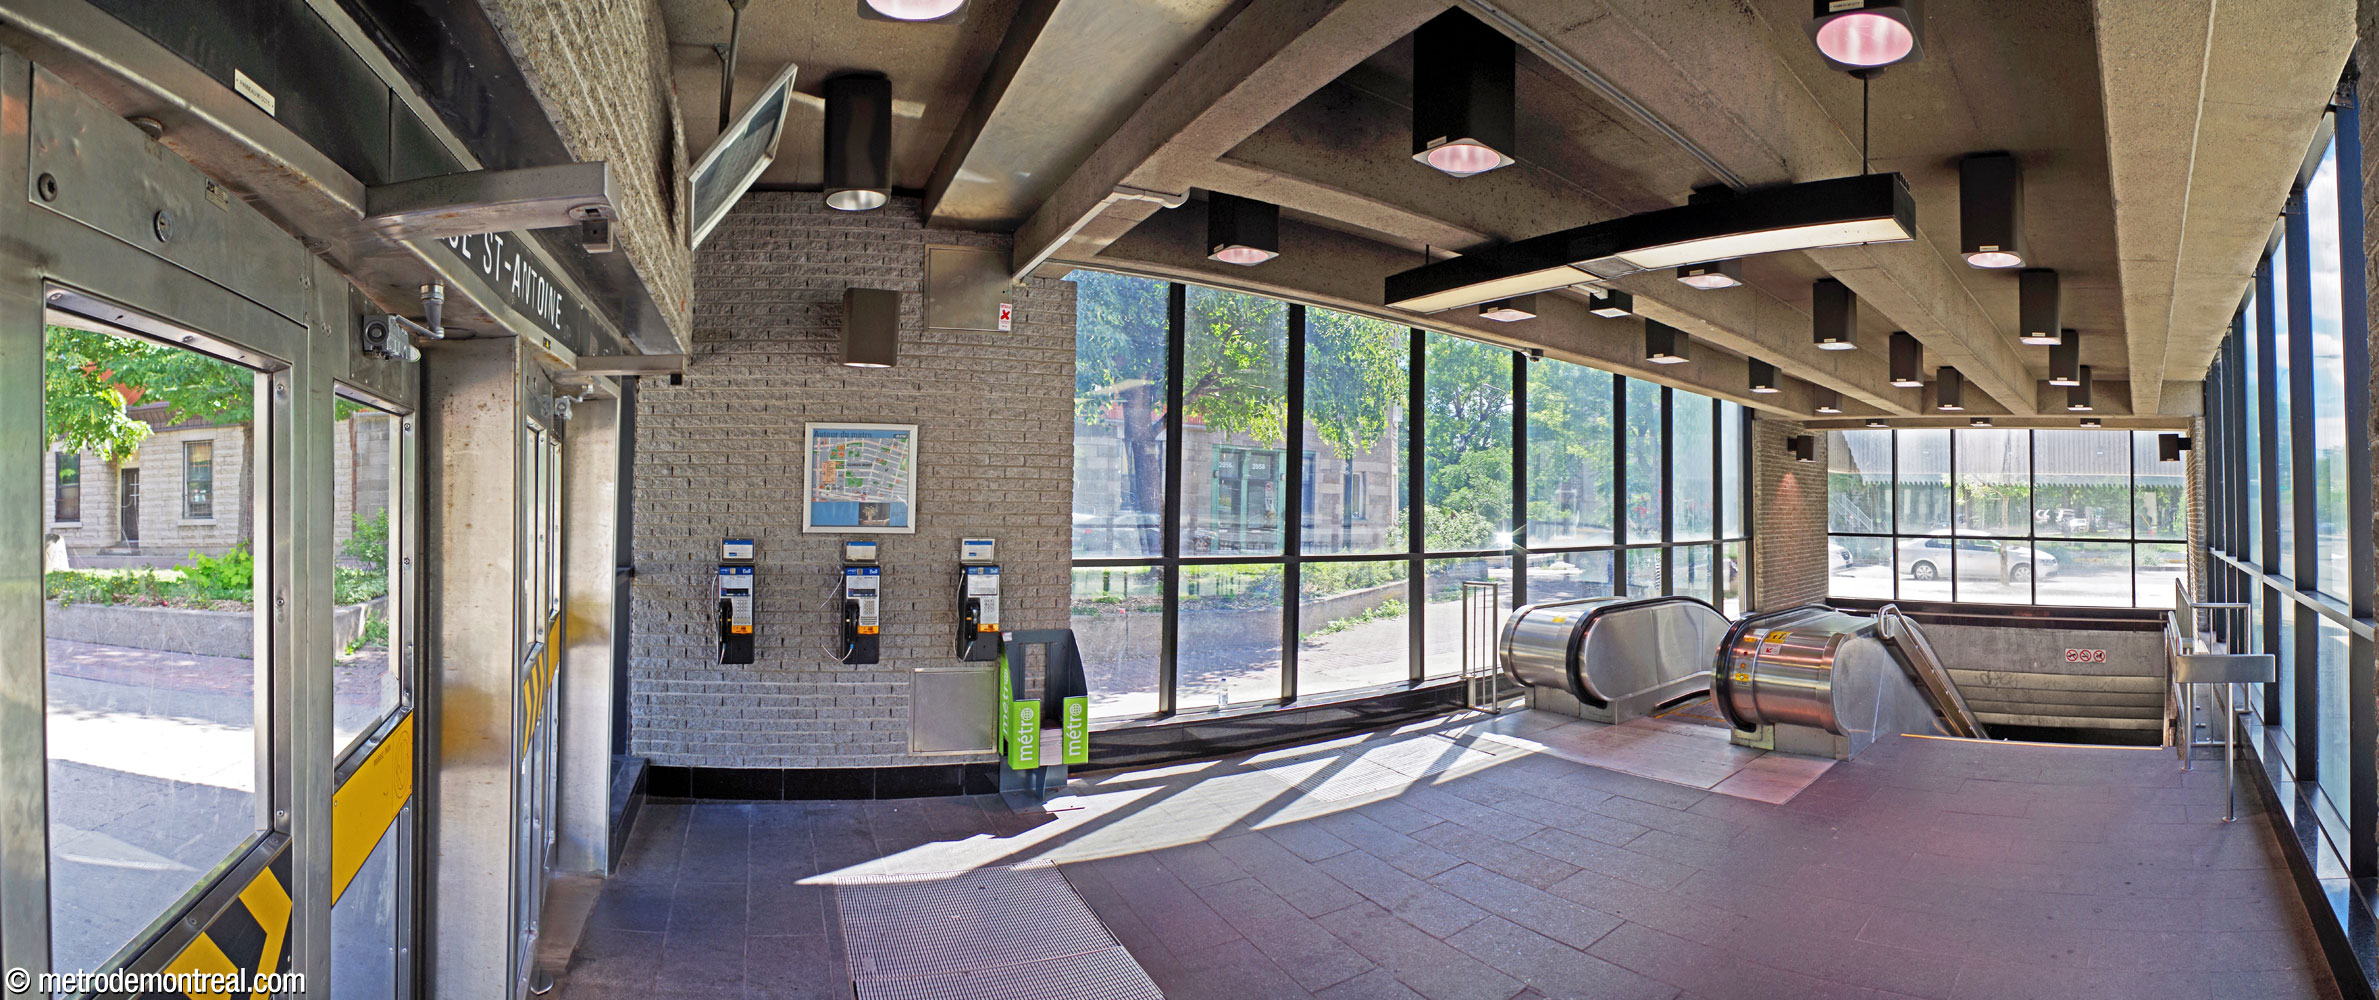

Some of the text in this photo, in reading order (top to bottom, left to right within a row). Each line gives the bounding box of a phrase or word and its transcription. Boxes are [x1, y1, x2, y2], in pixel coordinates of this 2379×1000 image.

[483, 231, 562, 330] ST-ANTOINE
[814, 430, 838, 438] Autour
[840, 430, 849, 438] du
[1018, 707, 1033, 761] métro
[1066, 703, 1081, 756] métro
